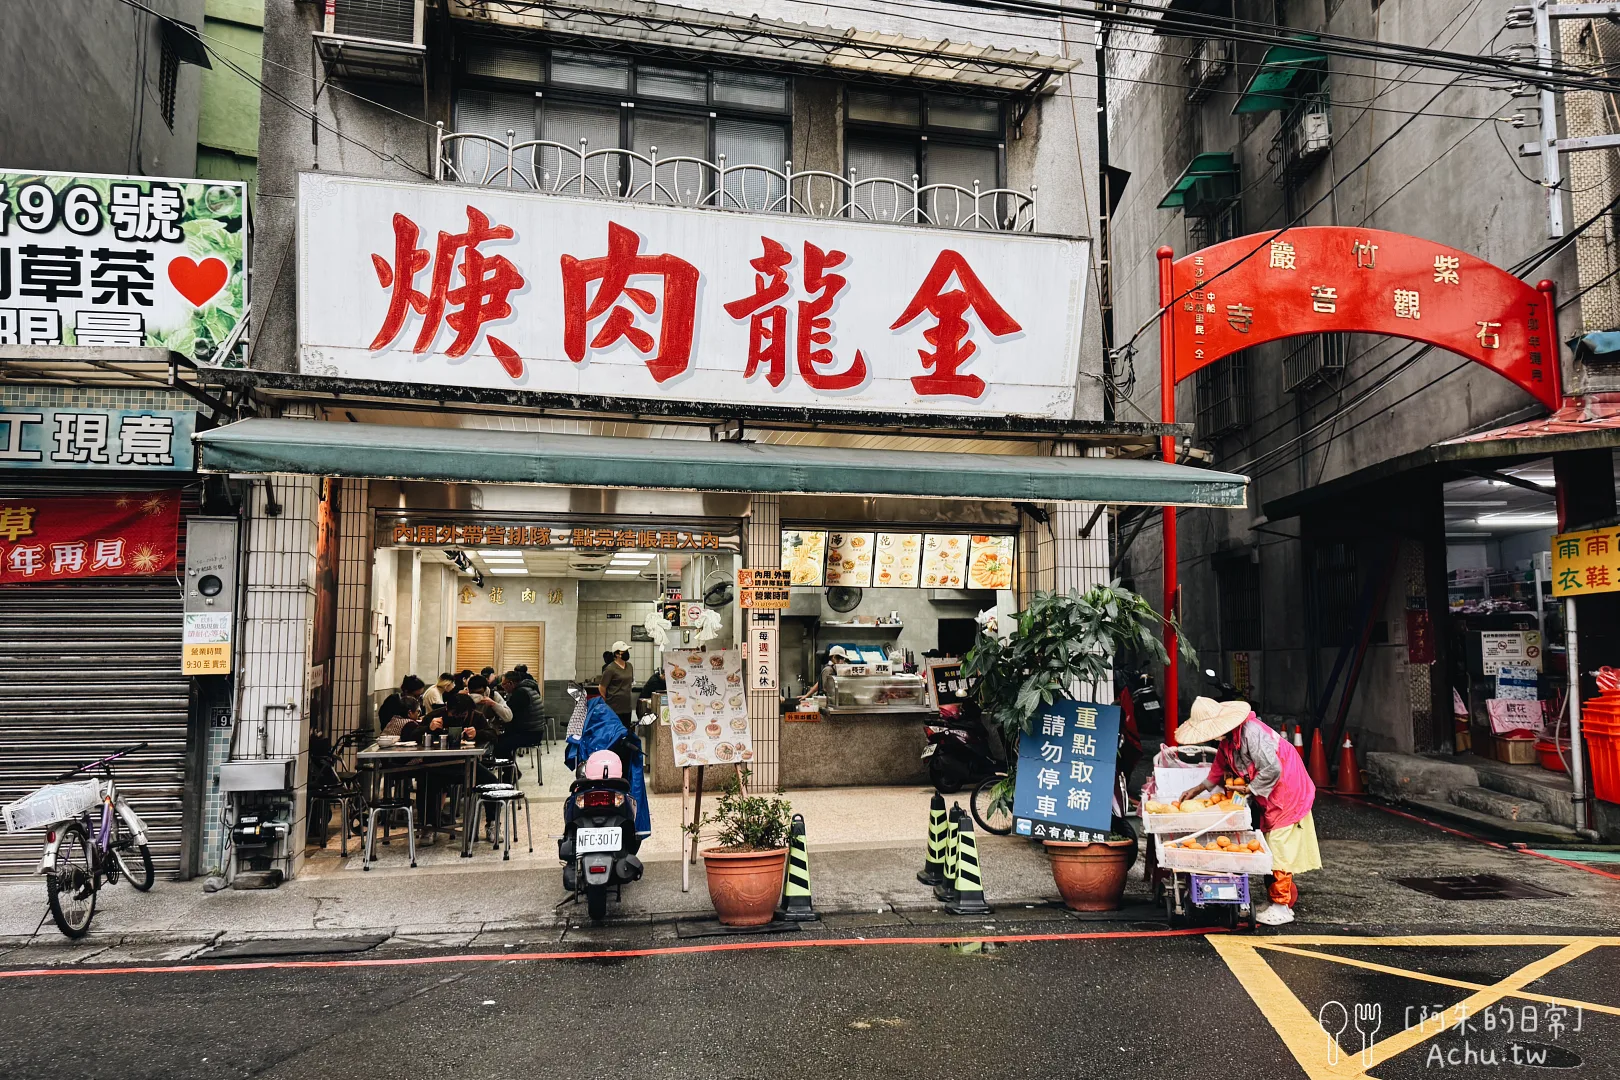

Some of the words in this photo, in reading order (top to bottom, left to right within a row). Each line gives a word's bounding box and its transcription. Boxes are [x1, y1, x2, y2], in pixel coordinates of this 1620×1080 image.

[0, 244, 154, 306] 草茶
[0, 412, 174, 465] 工現煮
[0, 506, 36, 541] 草
[0, 537, 126, 577] 年再見
[1557, 538, 1583, 591] 雨衣
[1585, 535, 1612, 589] 雨鞋
[755, 591, 789, 600] 營業時間
[186, 661, 202, 669] 9:30
[203, 660, 210, 669] 至
[191, 647, 222, 656] 營業時間
[759, 631, 769, 687] 每週二公休
[1034, 714, 1066, 818] 請勿停車
[1067, 706, 1099, 812] 重點取締
